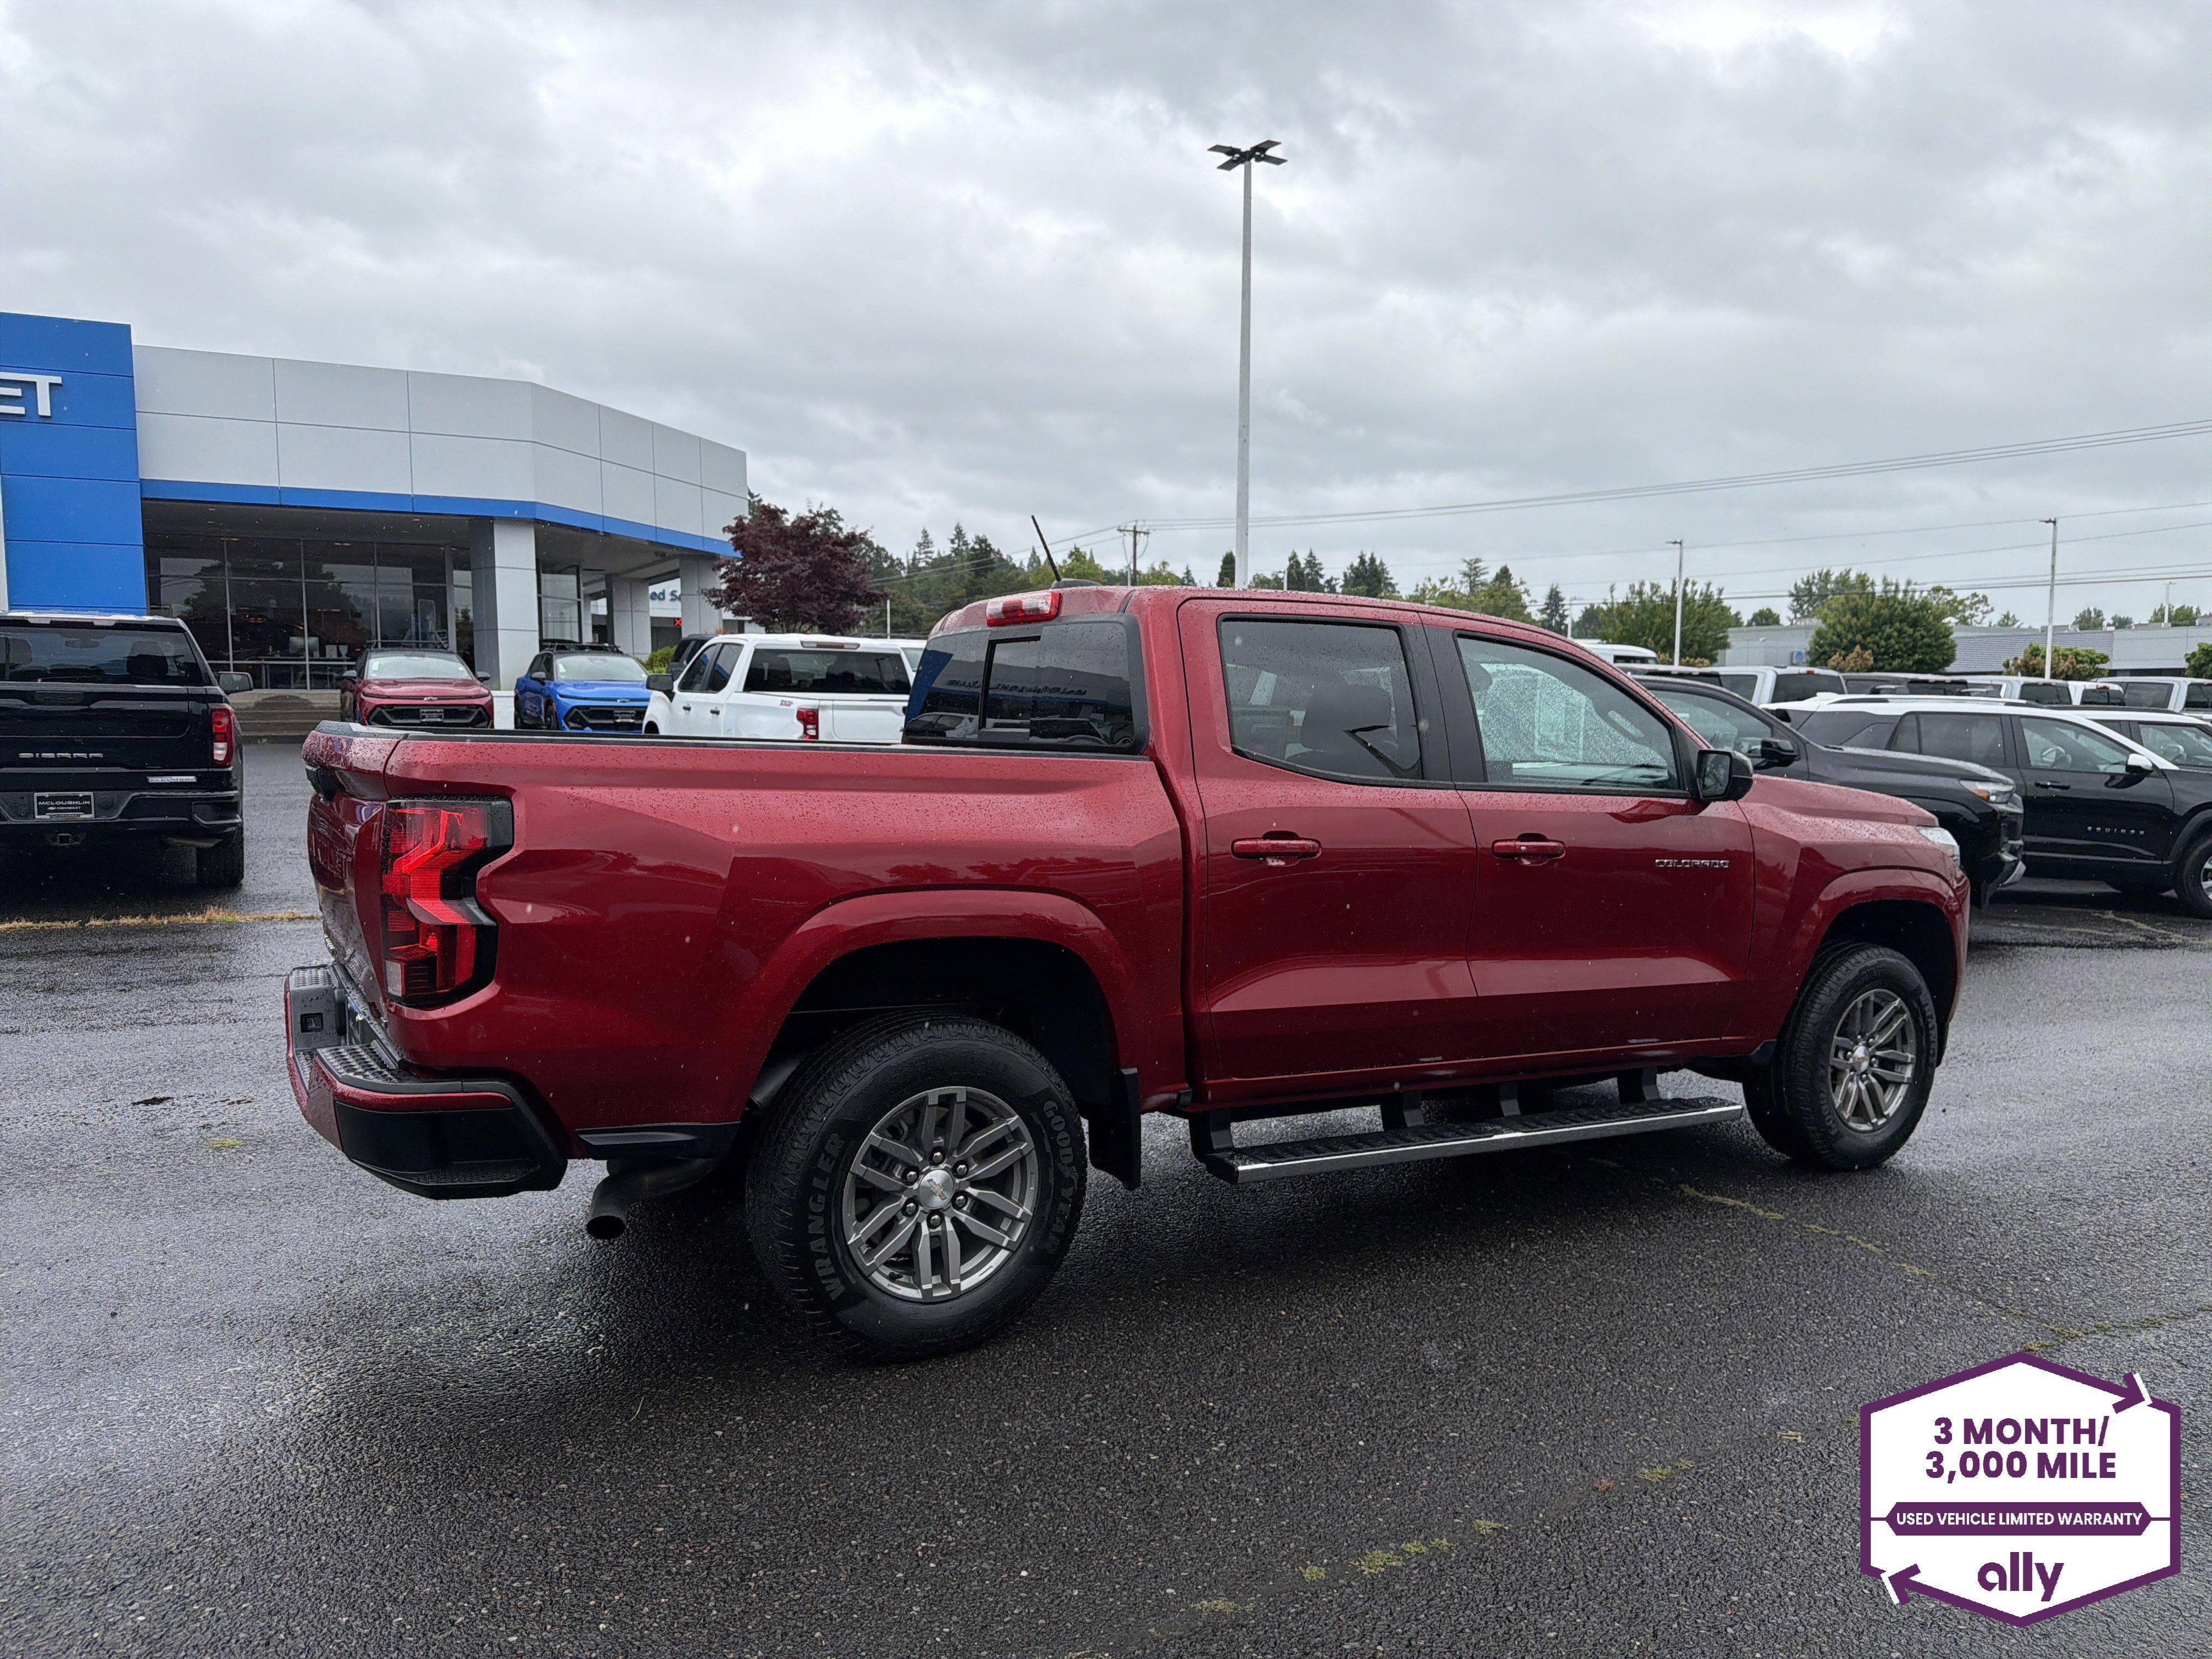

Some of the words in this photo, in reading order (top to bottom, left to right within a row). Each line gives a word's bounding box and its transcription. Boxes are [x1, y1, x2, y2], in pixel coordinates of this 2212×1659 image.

[0, 372, 62, 416] ET
[1655, 859, 1730, 868] COLORADO
[806, 1133, 846, 1301] WRANGLER
